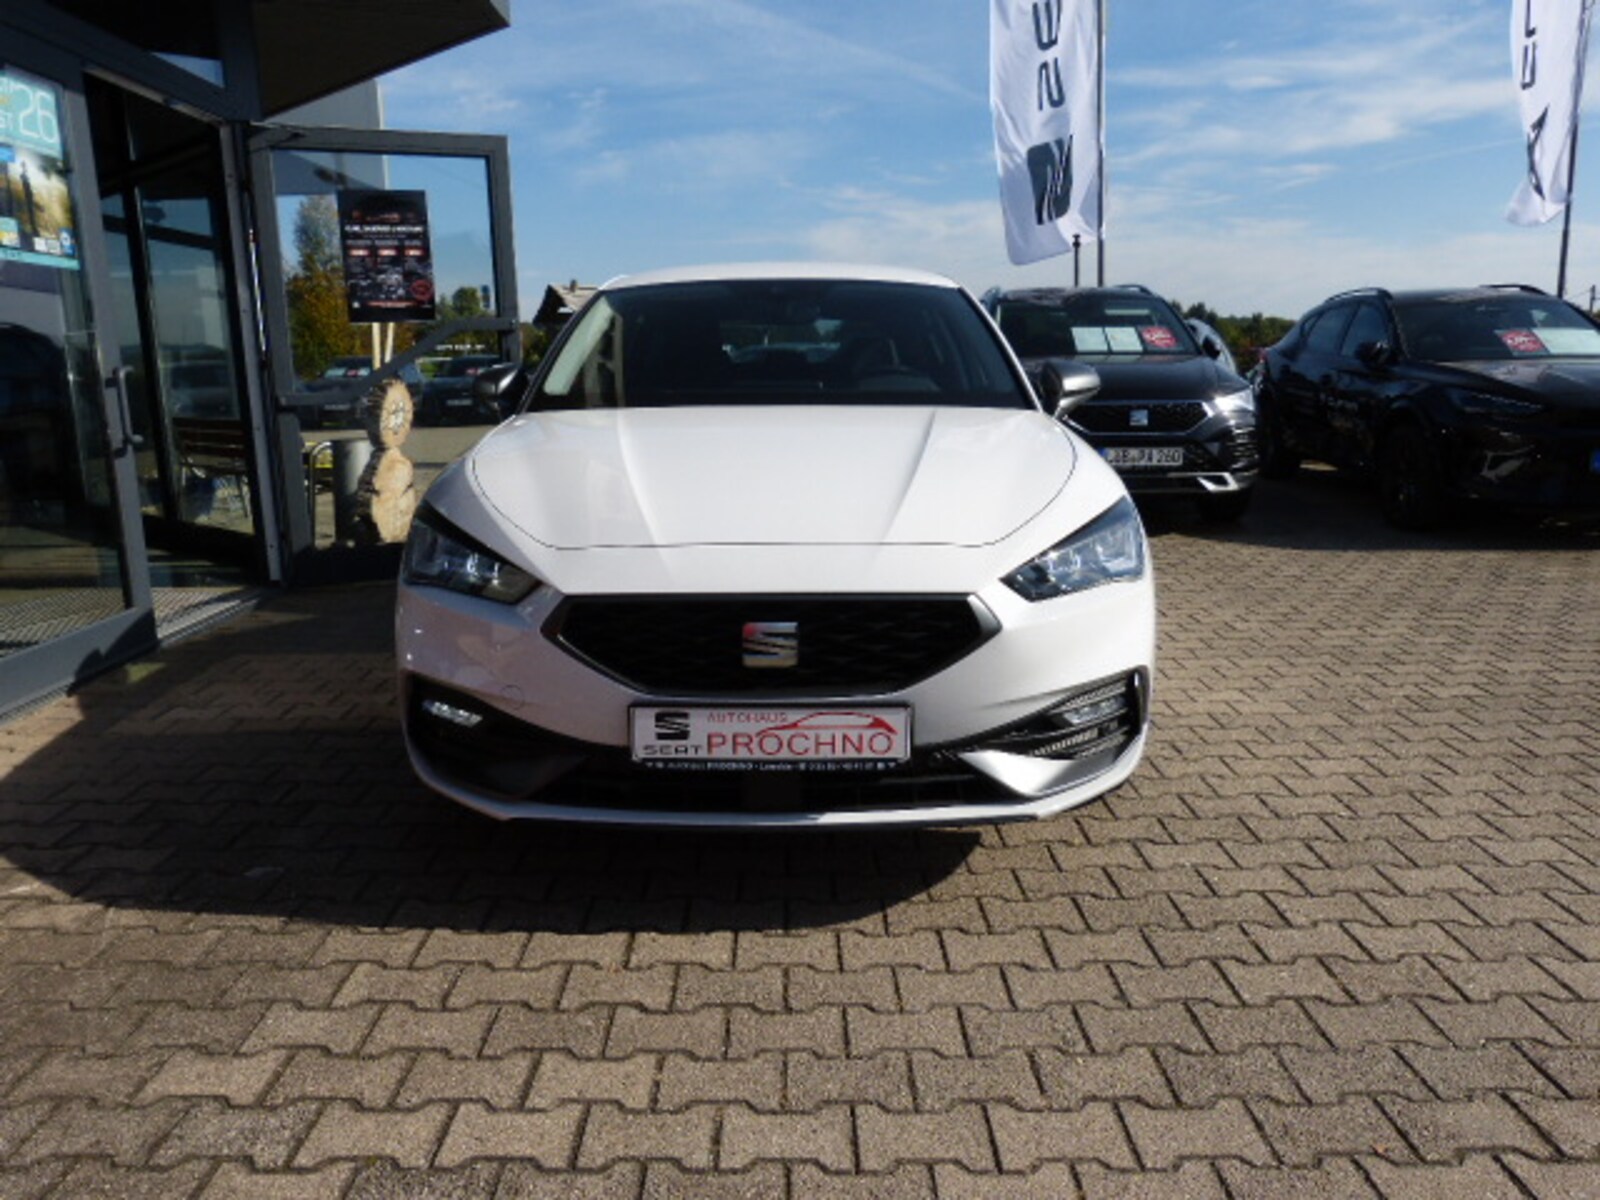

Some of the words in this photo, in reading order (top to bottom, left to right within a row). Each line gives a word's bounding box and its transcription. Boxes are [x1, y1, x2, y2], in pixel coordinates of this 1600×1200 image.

[14, 84, 59, 143] 26
[707, 711, 788, 724] AUTOHAUS
[643, 744, 702, 755] SEAT
[707, 732, 894, 756] PROCHNO
